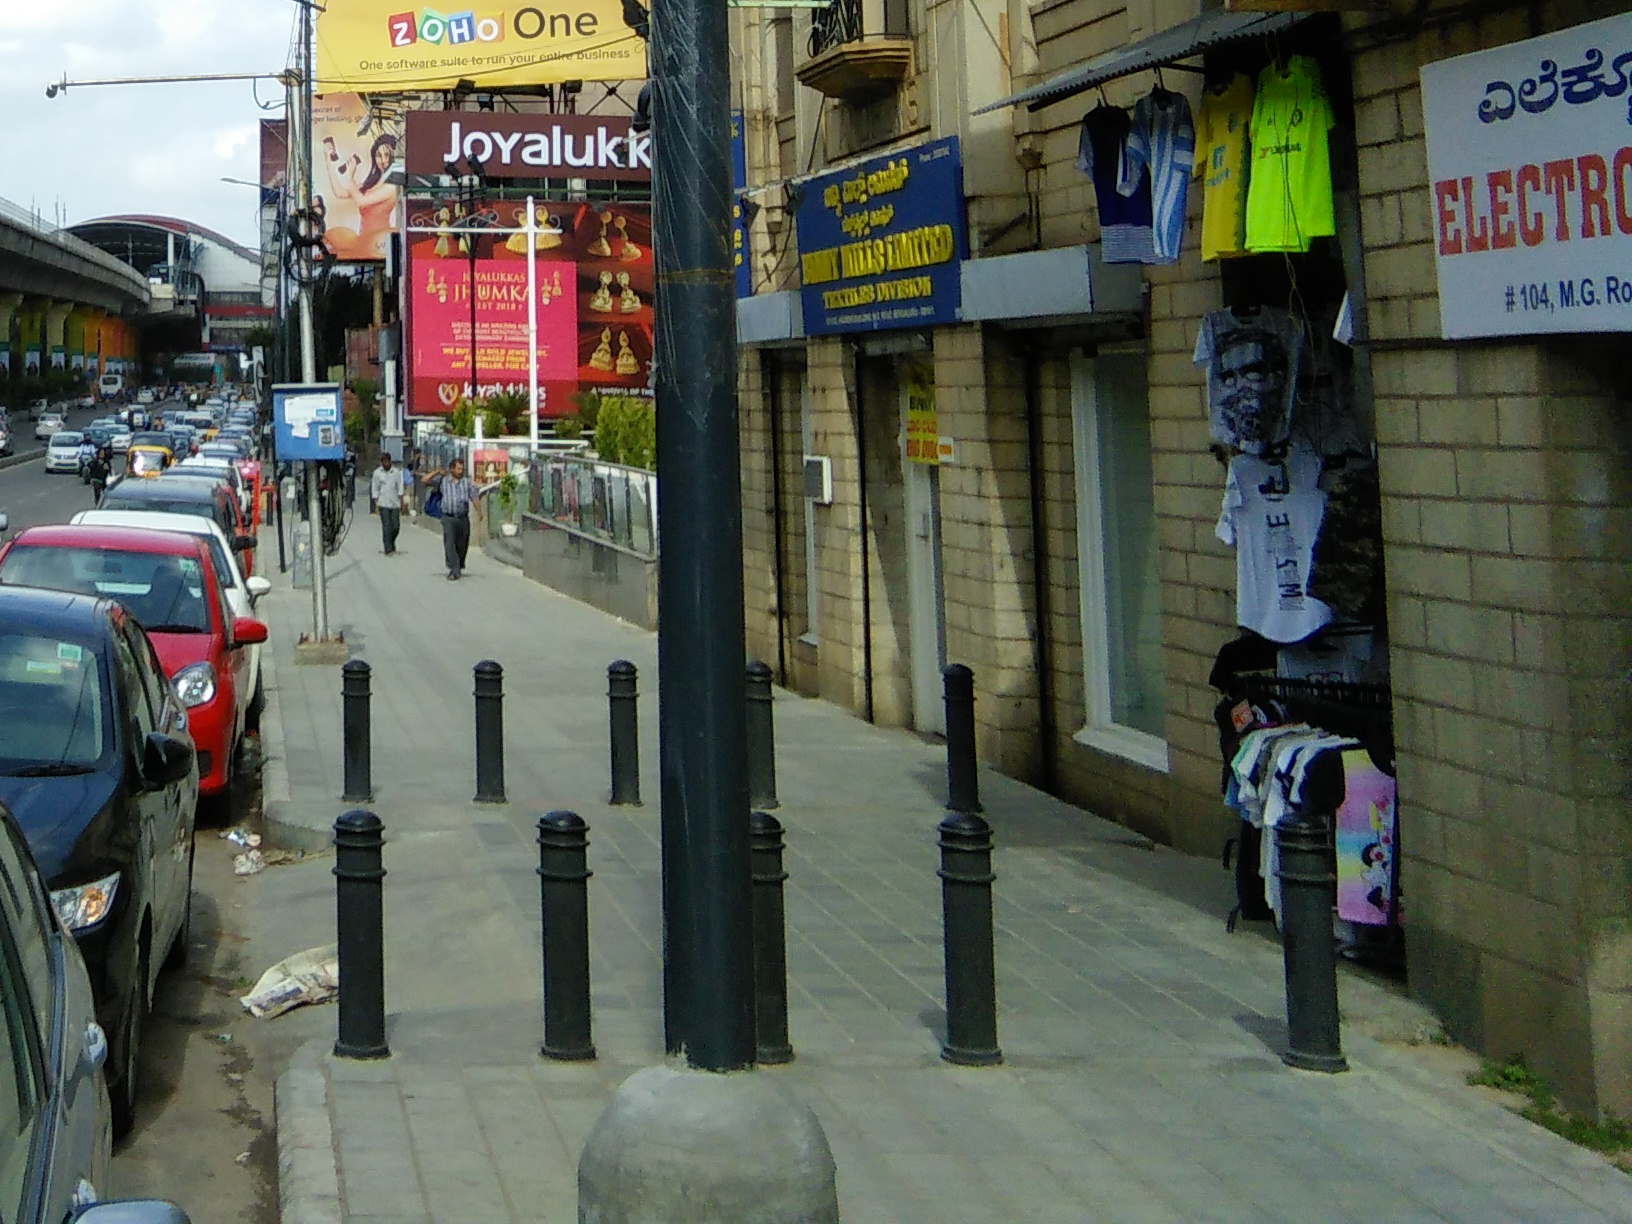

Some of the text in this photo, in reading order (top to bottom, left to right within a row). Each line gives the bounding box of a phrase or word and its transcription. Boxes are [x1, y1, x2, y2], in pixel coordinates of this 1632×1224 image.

[389, 6, 599, 47] ZOHO One
[359, 59, 384, 71] One
[386, 56, 438, 70] software
[486, 55, 507, 66] run
[509, 54, 536, 66] your
[576, 48, 631, 62] business
[443, 121, 652, 169] Joyalukk
[1434, 145, 1632, 257] ELECTRO
[885, 224, 955, 271] LIMITED
[875, 275, 932, 303] DIVISION
[1519, 282, 1555, 314] 104,
[1559, 278, 1601, 309] M.G.
